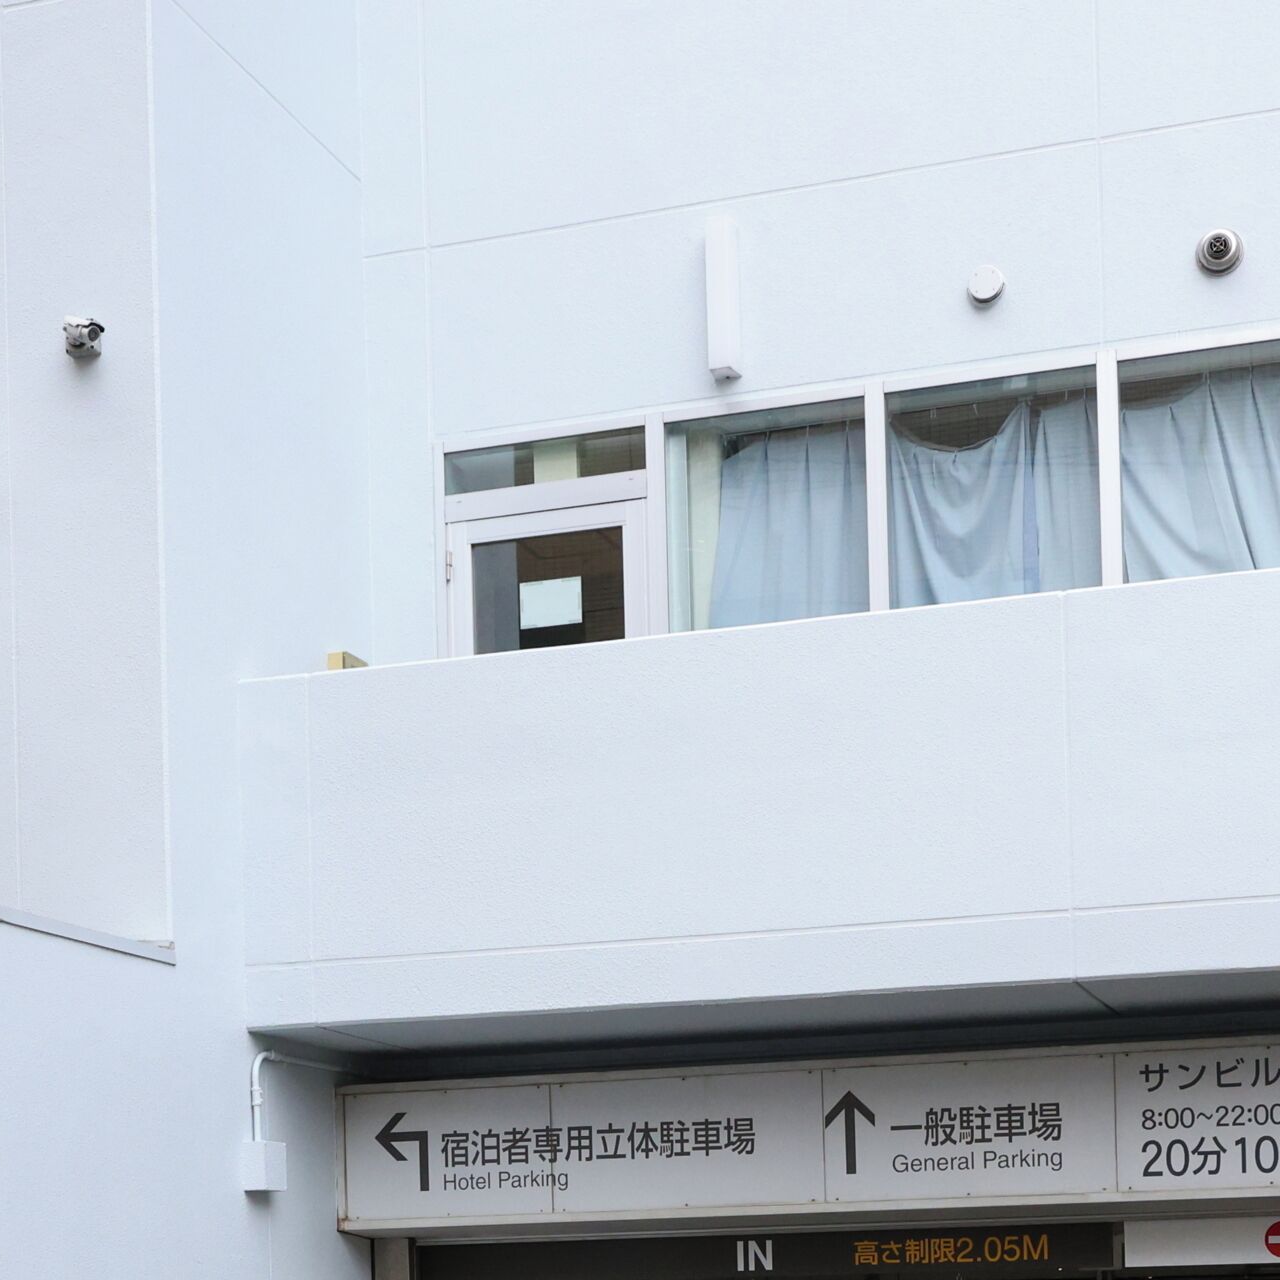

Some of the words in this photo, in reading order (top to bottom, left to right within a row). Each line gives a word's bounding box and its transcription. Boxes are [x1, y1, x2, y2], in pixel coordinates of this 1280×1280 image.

[890, 1101, 1063, 1146] 一般駐車場
[440, 1116, 756, 1168] 宿泊者専用立体駐車場
[892, 1151, 977, 1174] General
[984, 1149, 1063, 1173] Parking
[443, 1169, 493, 1191] Hotel
[499, 1168, 569, 1192] Parking
[736, 1240, 773, 1272] IN
[853, 1235, 1050, 1267] 高さ制限2.05M
